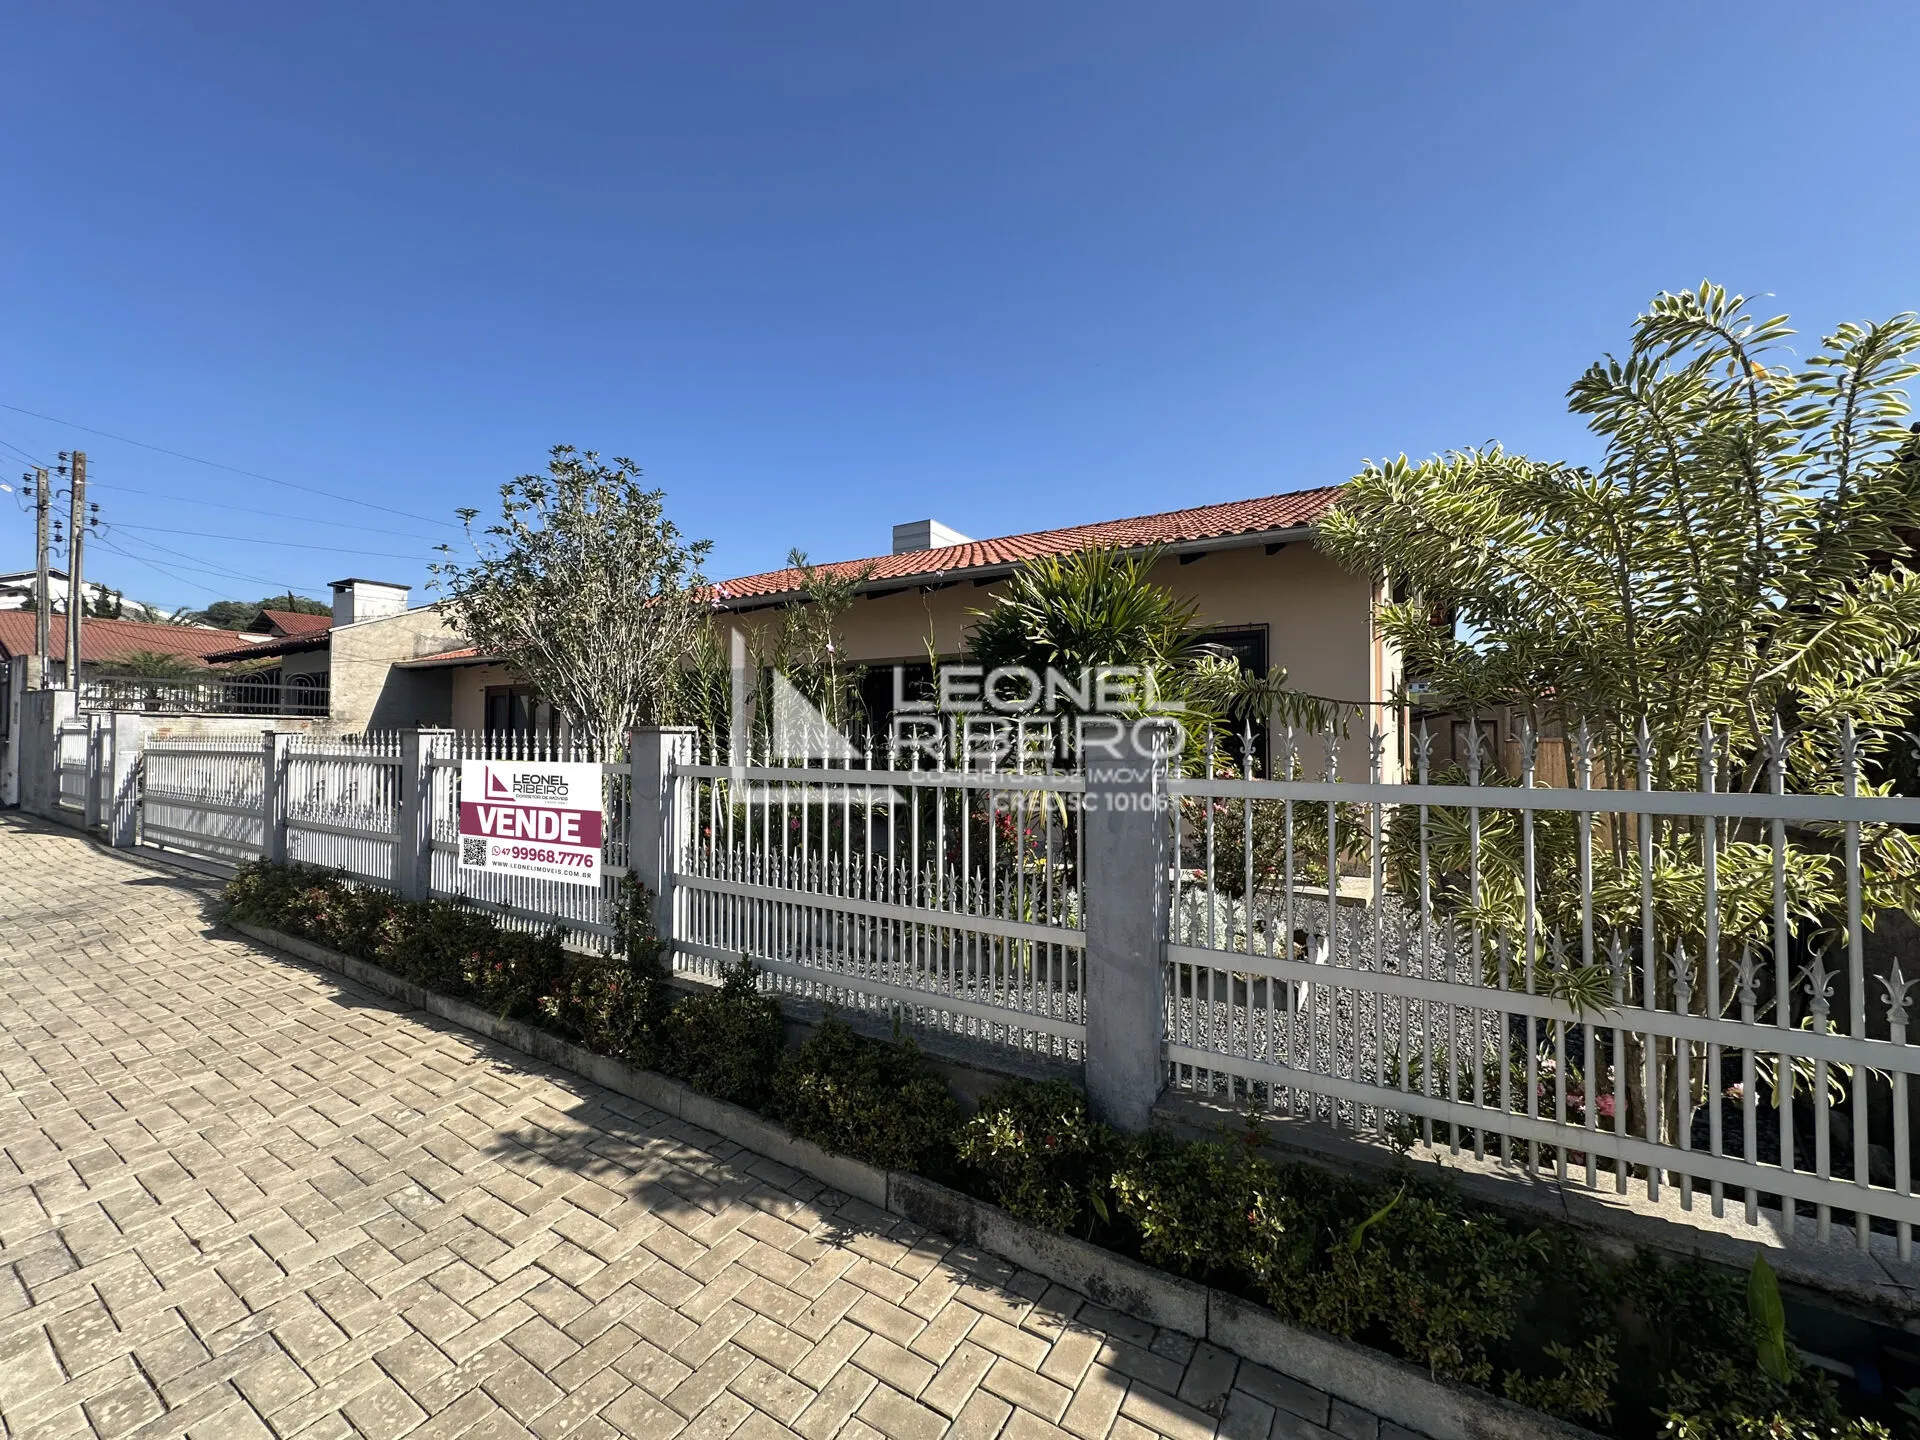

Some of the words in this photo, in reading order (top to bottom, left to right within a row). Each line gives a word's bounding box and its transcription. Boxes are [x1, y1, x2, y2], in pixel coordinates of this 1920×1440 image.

[513, 773, 568, 786] LEONEL
[513, 783, 568, 796] RIBEIRO
[476, 805, 582, 844] VENDE
[502, 848, 511, 856] 47
[512, 846, 594, 868] 99968.7776
